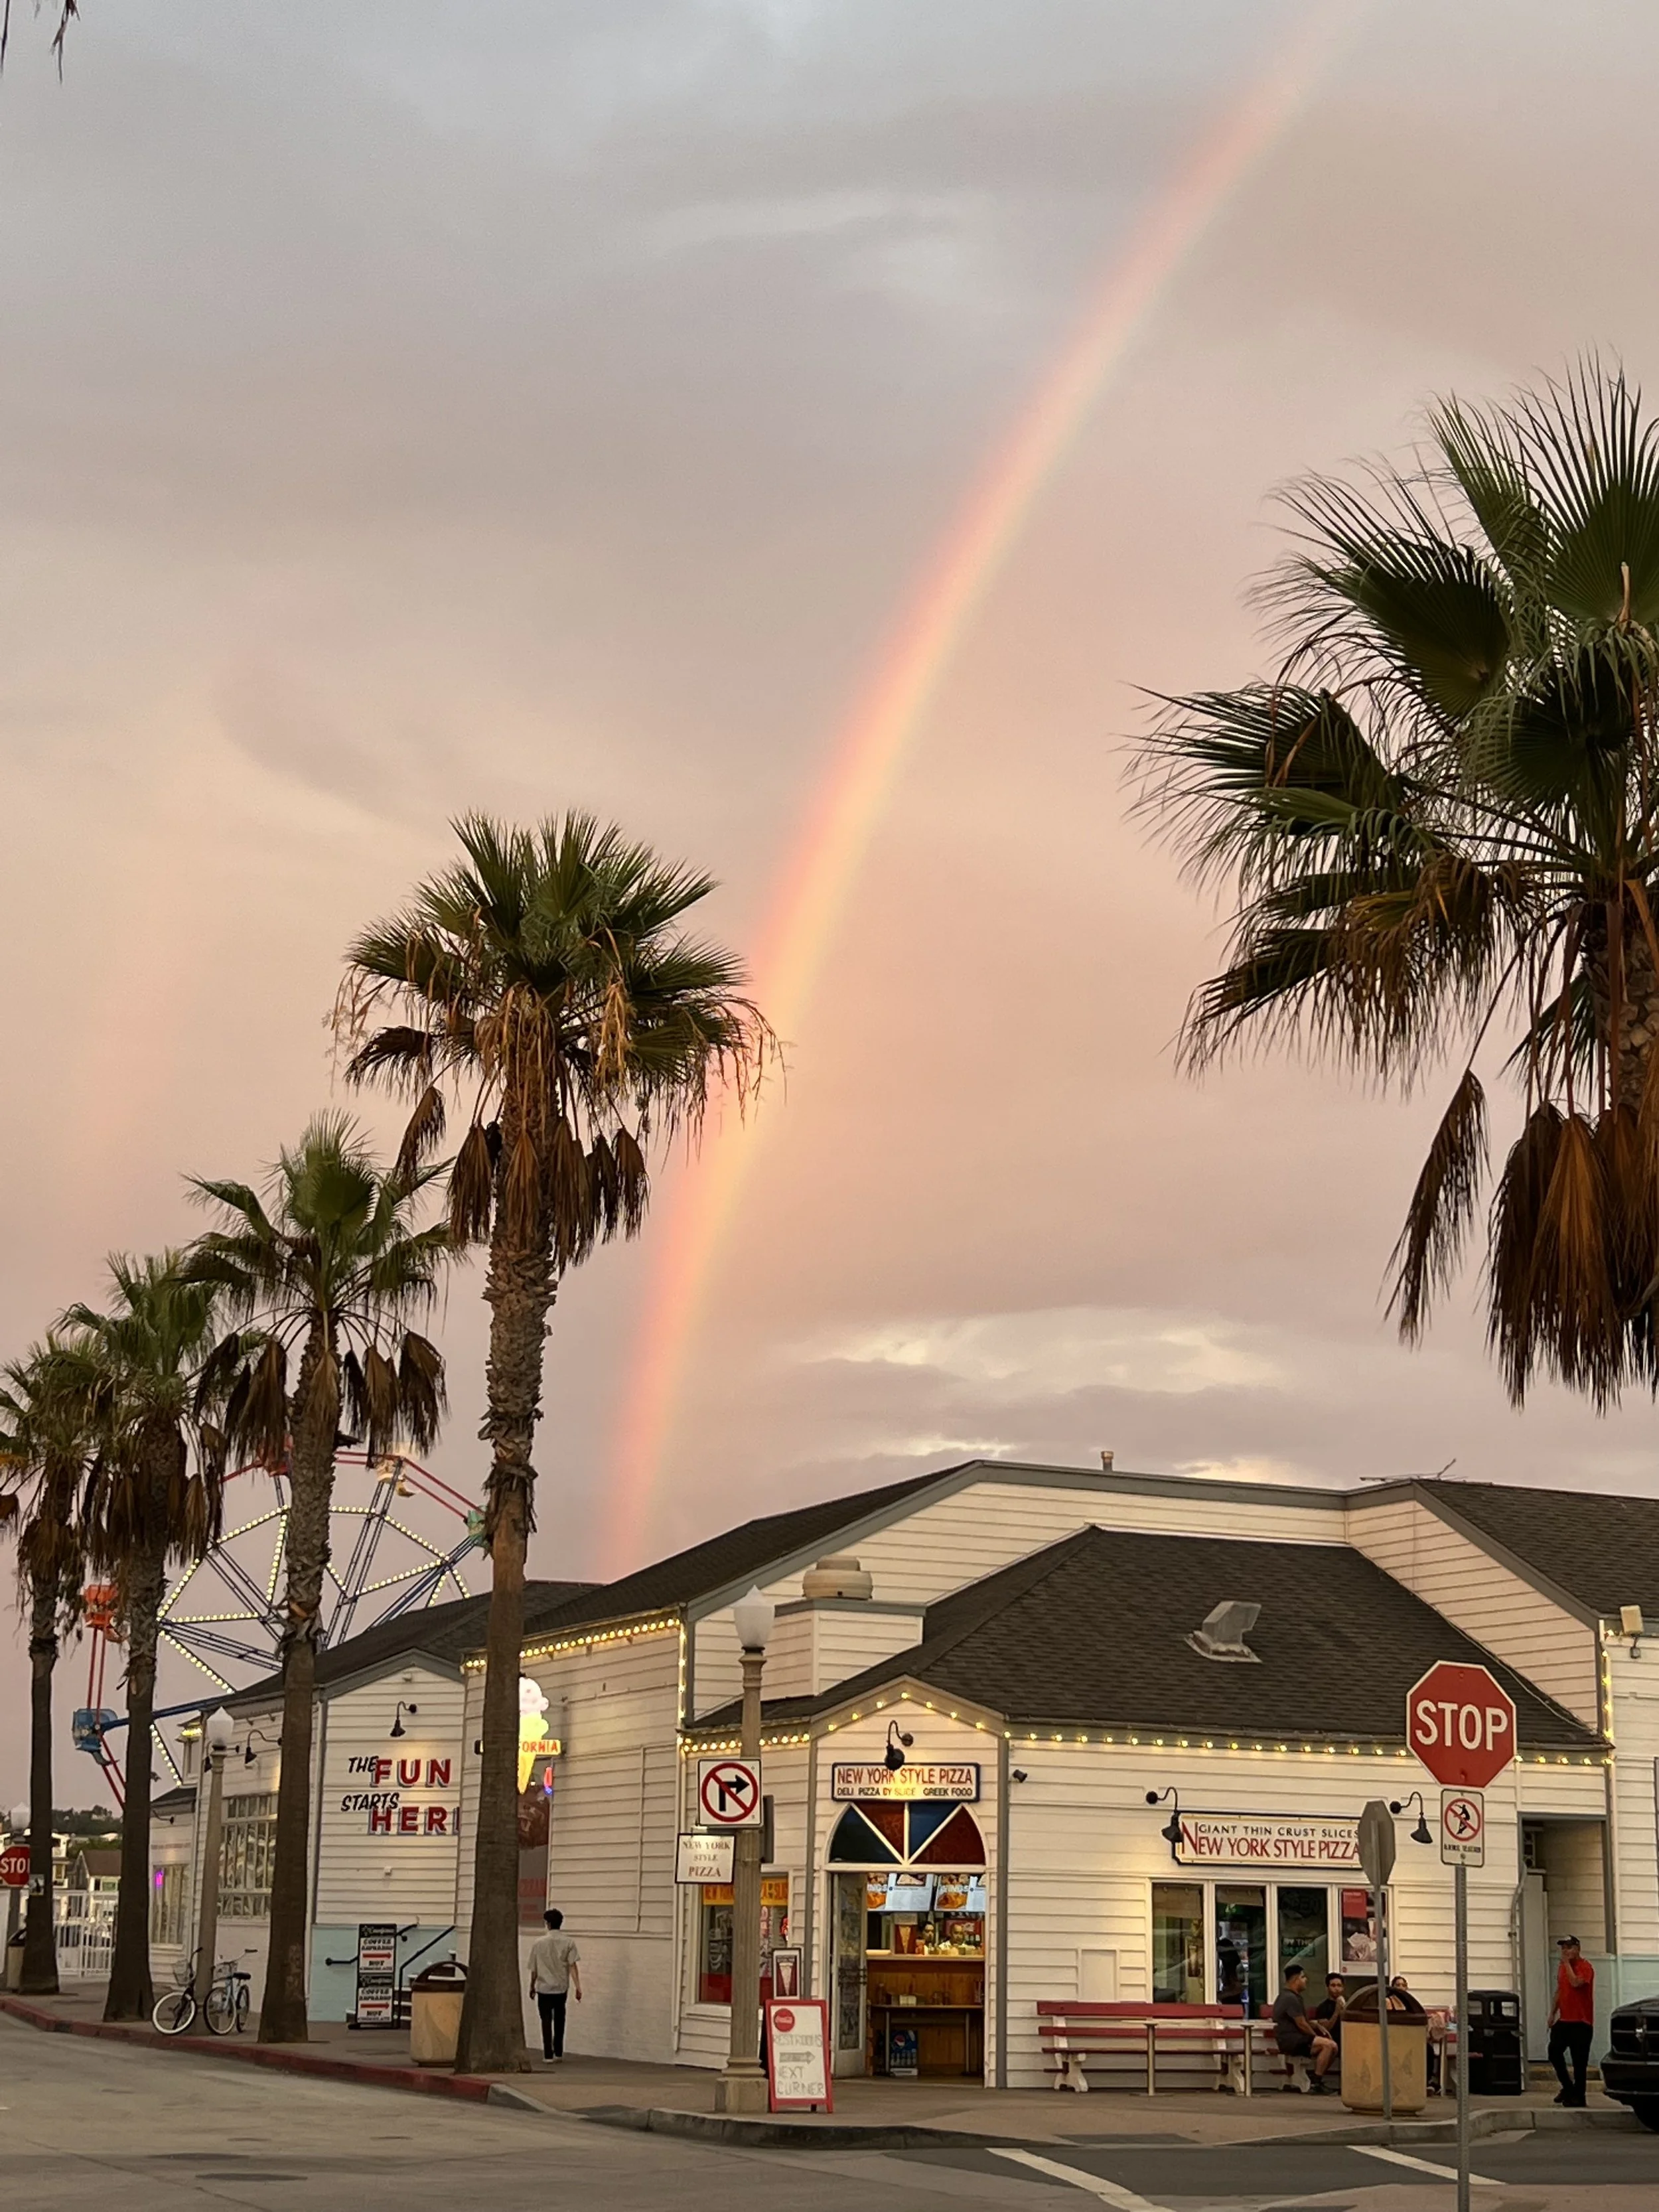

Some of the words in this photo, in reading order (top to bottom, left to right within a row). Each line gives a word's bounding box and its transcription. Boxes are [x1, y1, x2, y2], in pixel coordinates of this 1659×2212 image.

[1415, 1699, 1508, 1751] STOP
[519, 1741, 558, 1752] ORNIA
[348, 1755, 379, 1773] THE
[370, 1759, 451, 1787] FUN
[837, 1768, 863, 1784] NEW
[867, 1768, 896, 1784] YORK
[900, 1768, 935, 1784] STYLE
[939, 1768, 973, 1784] PIZZA
[837, 1787, 854, 1796] DELI
[858, 1787, 880, 1796] PIZZA
[883, 1787, 893, 1796] BY
[895, 1787, 916, 1796] SLICE
[923, 1787, 949, 1796] GREEK
[952, 1787, 973, 1796] FOOD
[340, 1793, 399, 1811] STARTS
[1198, 1824, 1238, 1834] GIANT
[1243, 1826, 1272, 1836] THIN
[1277, 1826, 1316, 1837] CRUST
[1321, 1828, 1358, 1838] SLICES
[683, 1840, 701, 1849] NEW
[1181, 1821, 1223, 1856] NEW
[1228, 1837, 1271, 1858] YORK
[1273, 1838, 1316, 1859] STYLE
[1319, 1840, 1359, 1860] PIZZA
[0, 1857, 30, 1874] STO
[687, 1866, 721, 1877] PIZZA
